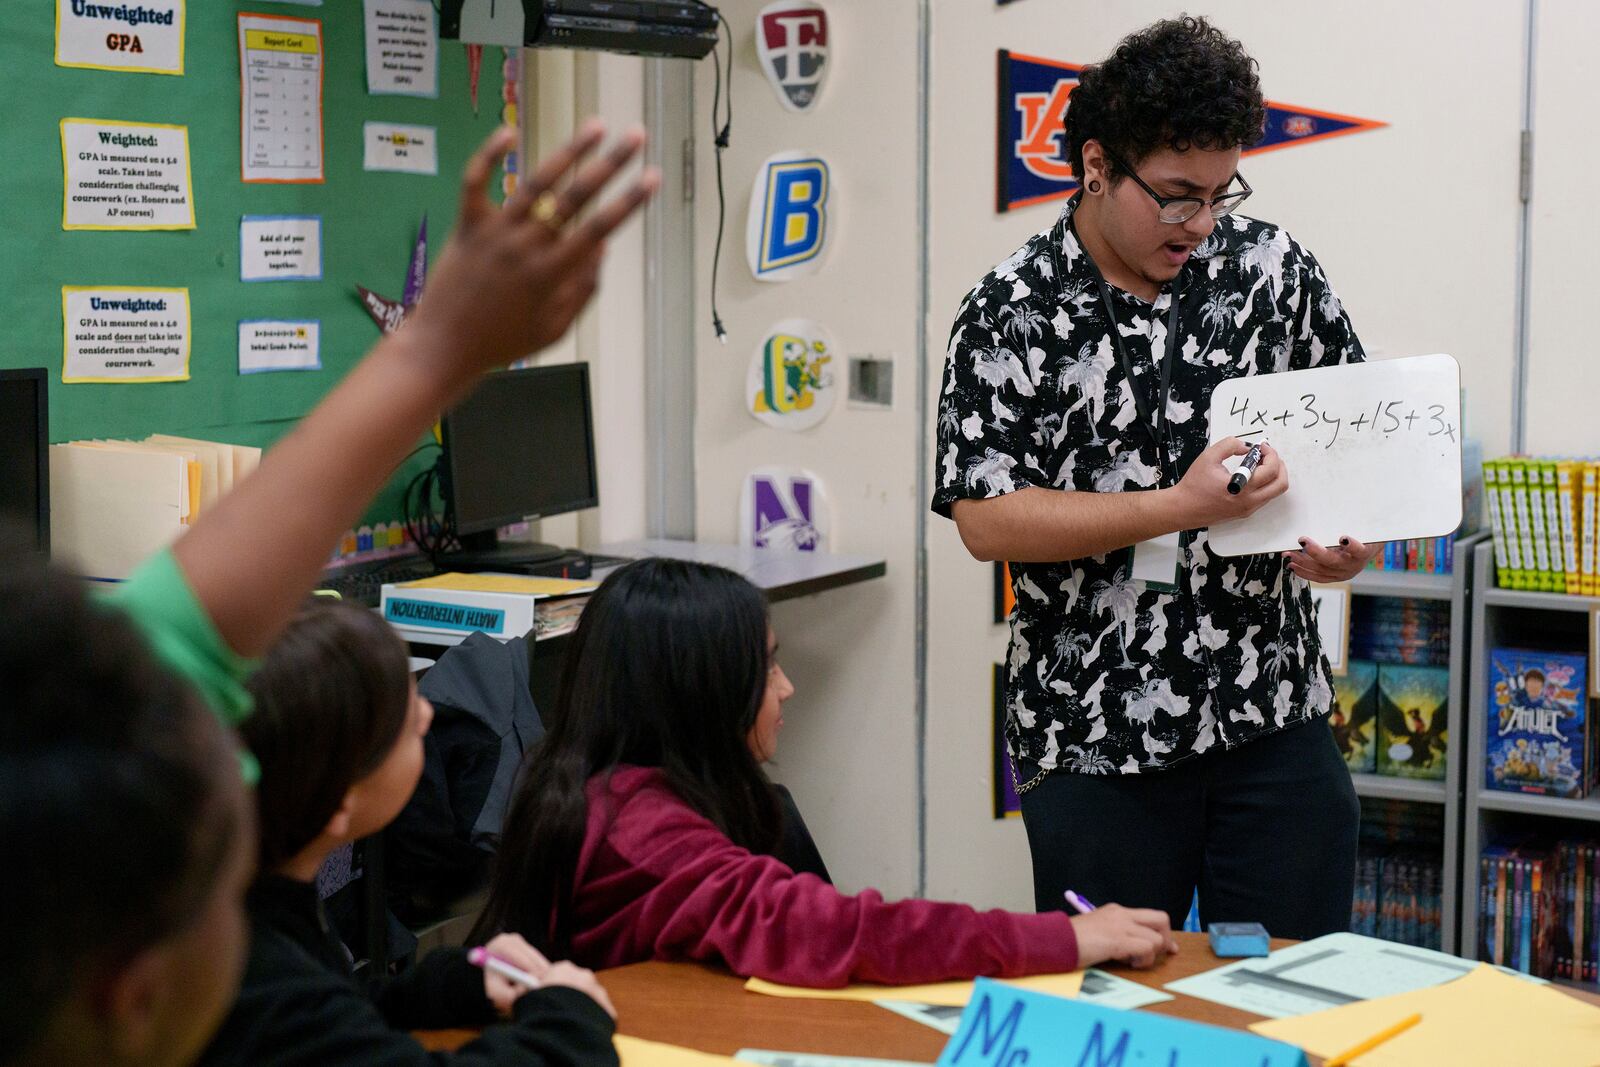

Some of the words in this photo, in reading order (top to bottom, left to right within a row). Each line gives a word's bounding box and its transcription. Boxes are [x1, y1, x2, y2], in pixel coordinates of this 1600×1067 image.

[71, 0, 174, 26] Unweighted
[106, 33, 143, 53] GPA
[264, 36, 285, 47] Report
[286, 38, 303, 48] Card
[98, 131, 158, 148] Weighted:
[79, 152, 99, 161] GPA
[101, 153, 108, 162] is
[110, 154, 148, 163] measured
[166, 157, 178, 165] 5.0
[98, 168, 120, 176] scale.
[122, 168, 145, 176] Takes
[147, 168, 162, 177] into
[79, 181, 134, 190] consideration
[136, 182, 179, 192] challenging
[72, 195, 122, 203] coursework
[124, 196, 139, 205] (ex.
[141, 196, 169, 204] Honors
[171, 196, 186, 204] and
[107, 208, 119, 217] AP
[120, 209, 154, 219] courses)
[757, 158, 829, 274] B
[260, 234, 273, 242] Add
[90, 297, 167, 313] Unweighted:
[80, 319, 99, 328] GPA
[100, 319, 107, 328] is
[109, 319, 148, 328] measured
[166, 321, 178, 329] 4.0
[75, 332, 95, 341] scale
[97, 332, 113, 341] and
[114, 332, 132, 341] does
[134, 333, 147, 341] not
[148, 332, 165, 341] take
[167, 333, 182, 341] into
[78, 346, 134, 354] consideration
[136, 346, 179, 355] challenging
[105, 360, 155, 368] coursework.
[391, 601, 464, 627] INTERVENTION
[464, 610, 500, 629] MATH
